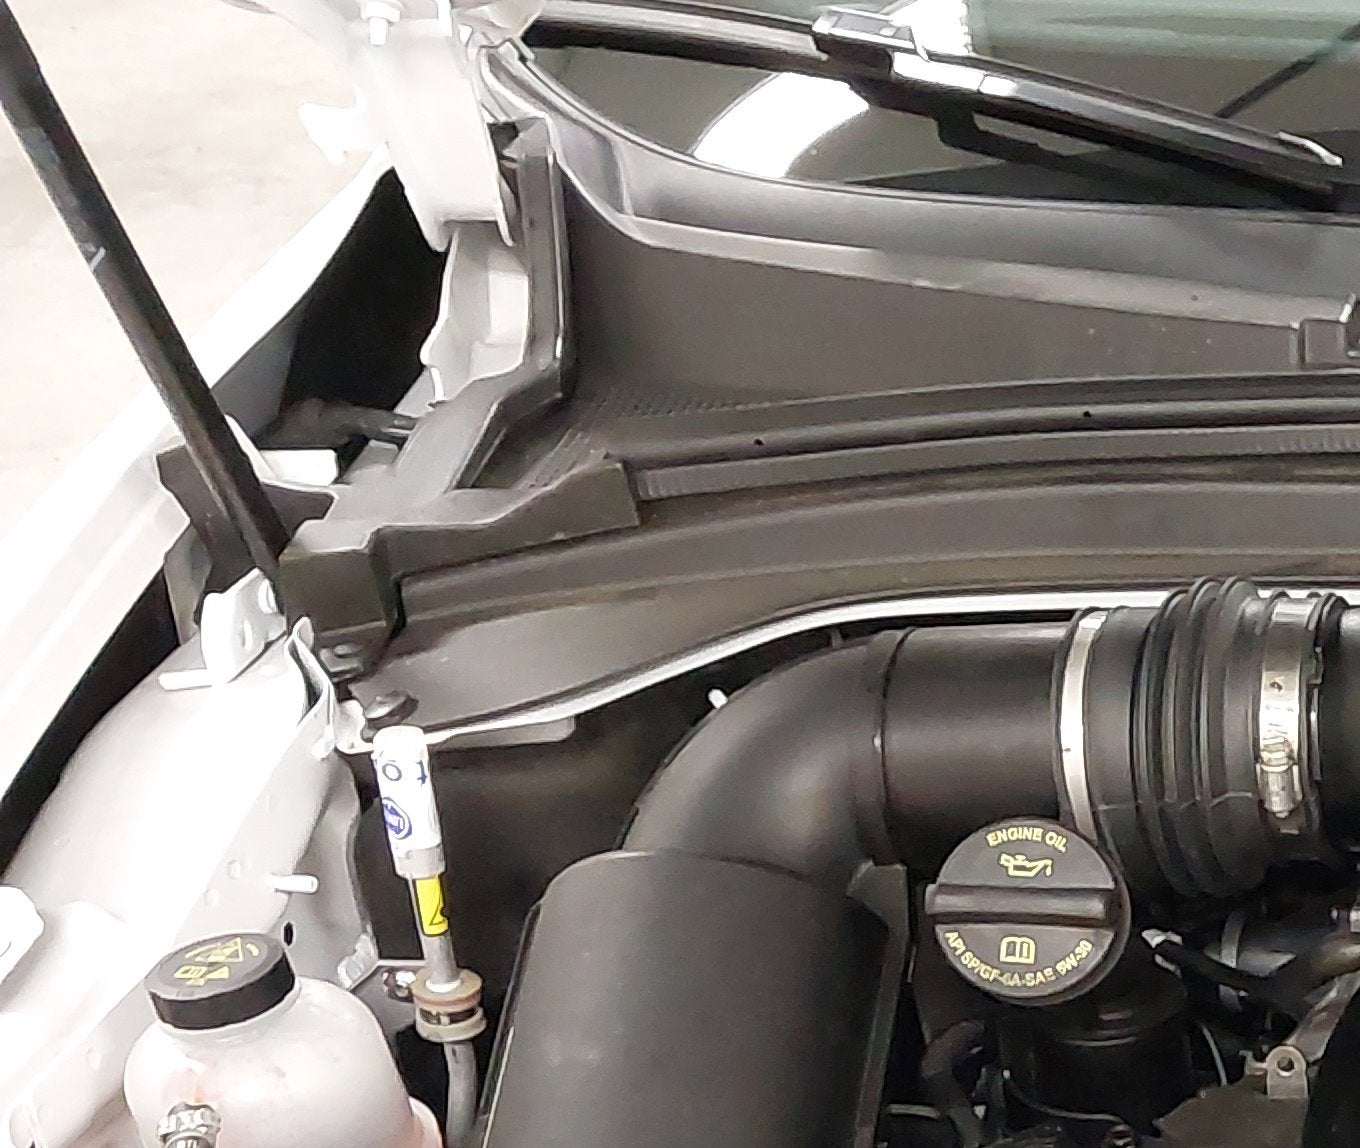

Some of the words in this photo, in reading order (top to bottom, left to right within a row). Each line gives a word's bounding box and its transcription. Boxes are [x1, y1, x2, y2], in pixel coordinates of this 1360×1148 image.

[986, 826, 1043, 847] ENGINE
[1045, 831, 1067, 853] OIL
[944, 931, 966, 957] API
